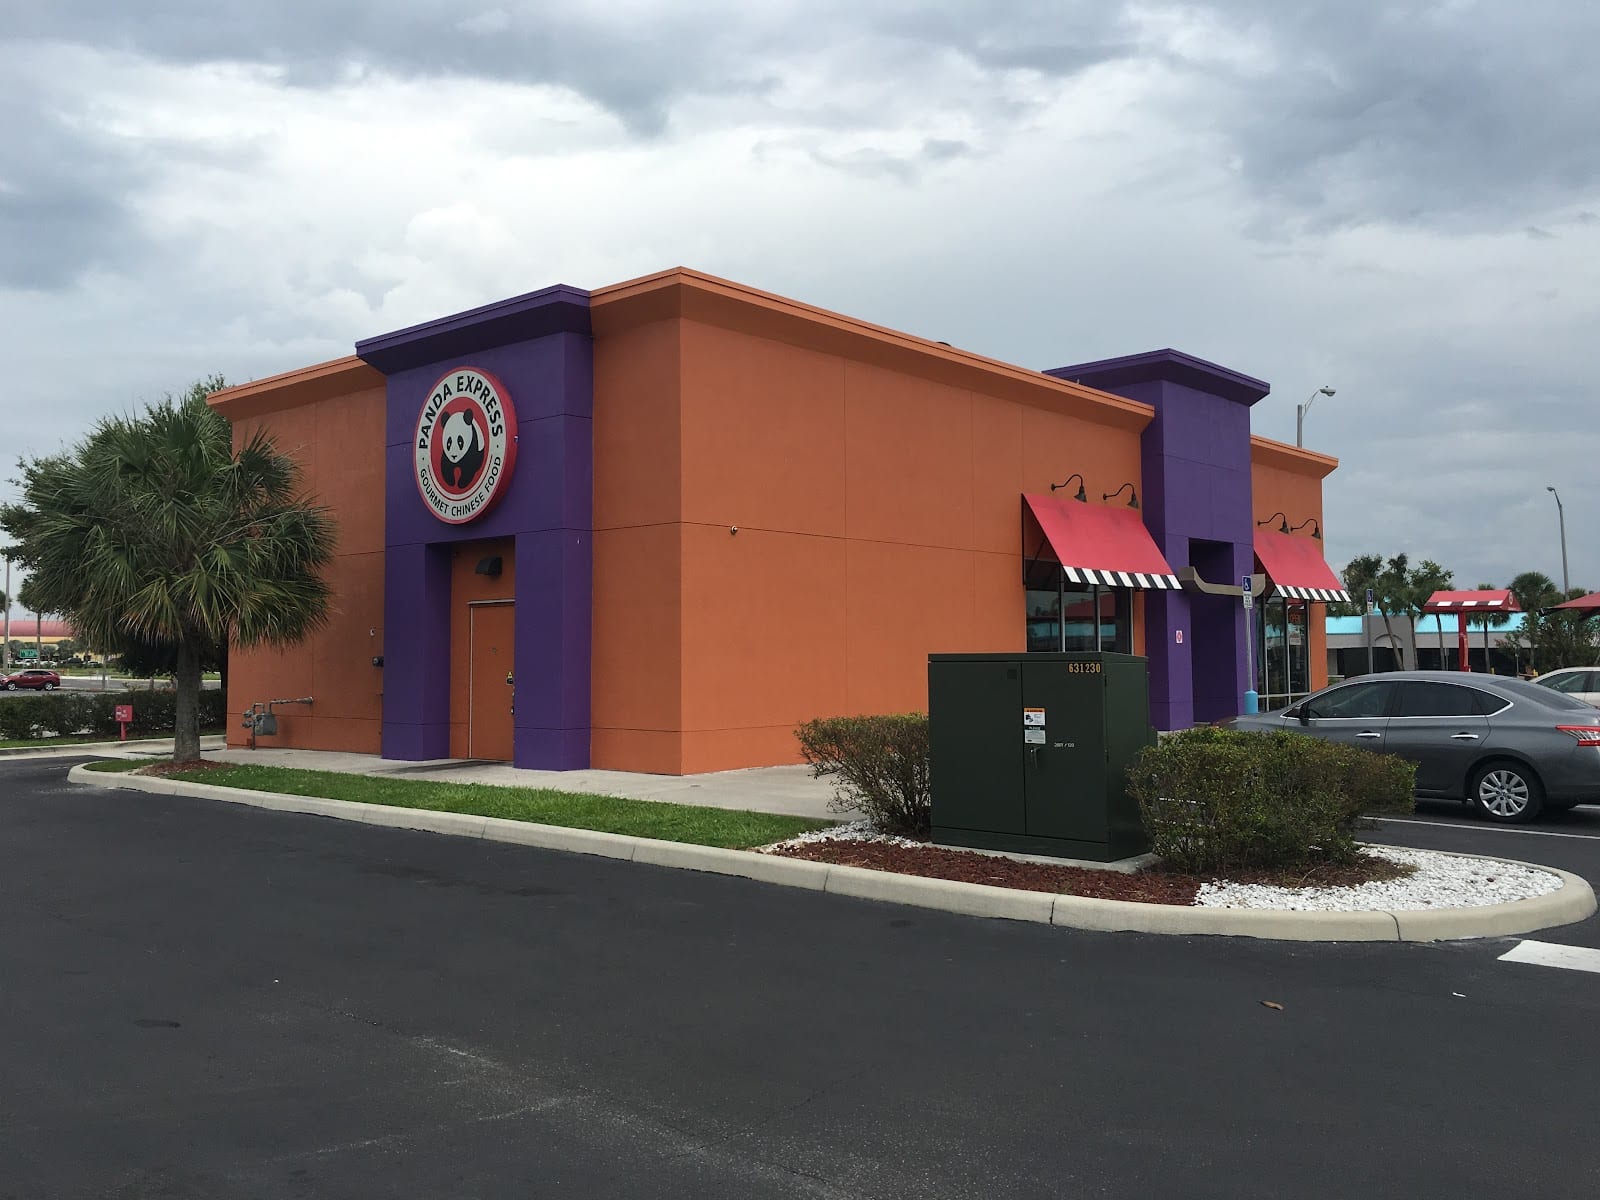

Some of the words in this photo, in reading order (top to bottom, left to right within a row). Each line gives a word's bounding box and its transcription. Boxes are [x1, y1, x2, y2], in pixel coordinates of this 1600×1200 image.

[419, 383, 453, 449] PANDA
[456, 375, 503, 437] EXPRESS
[420, 468, 449, 514] GOURMET
[451, 492, 485, 517] CHINESE
[484, 456, 501, 493] FOOD
[1068, 663, 1101, 673] 631230
